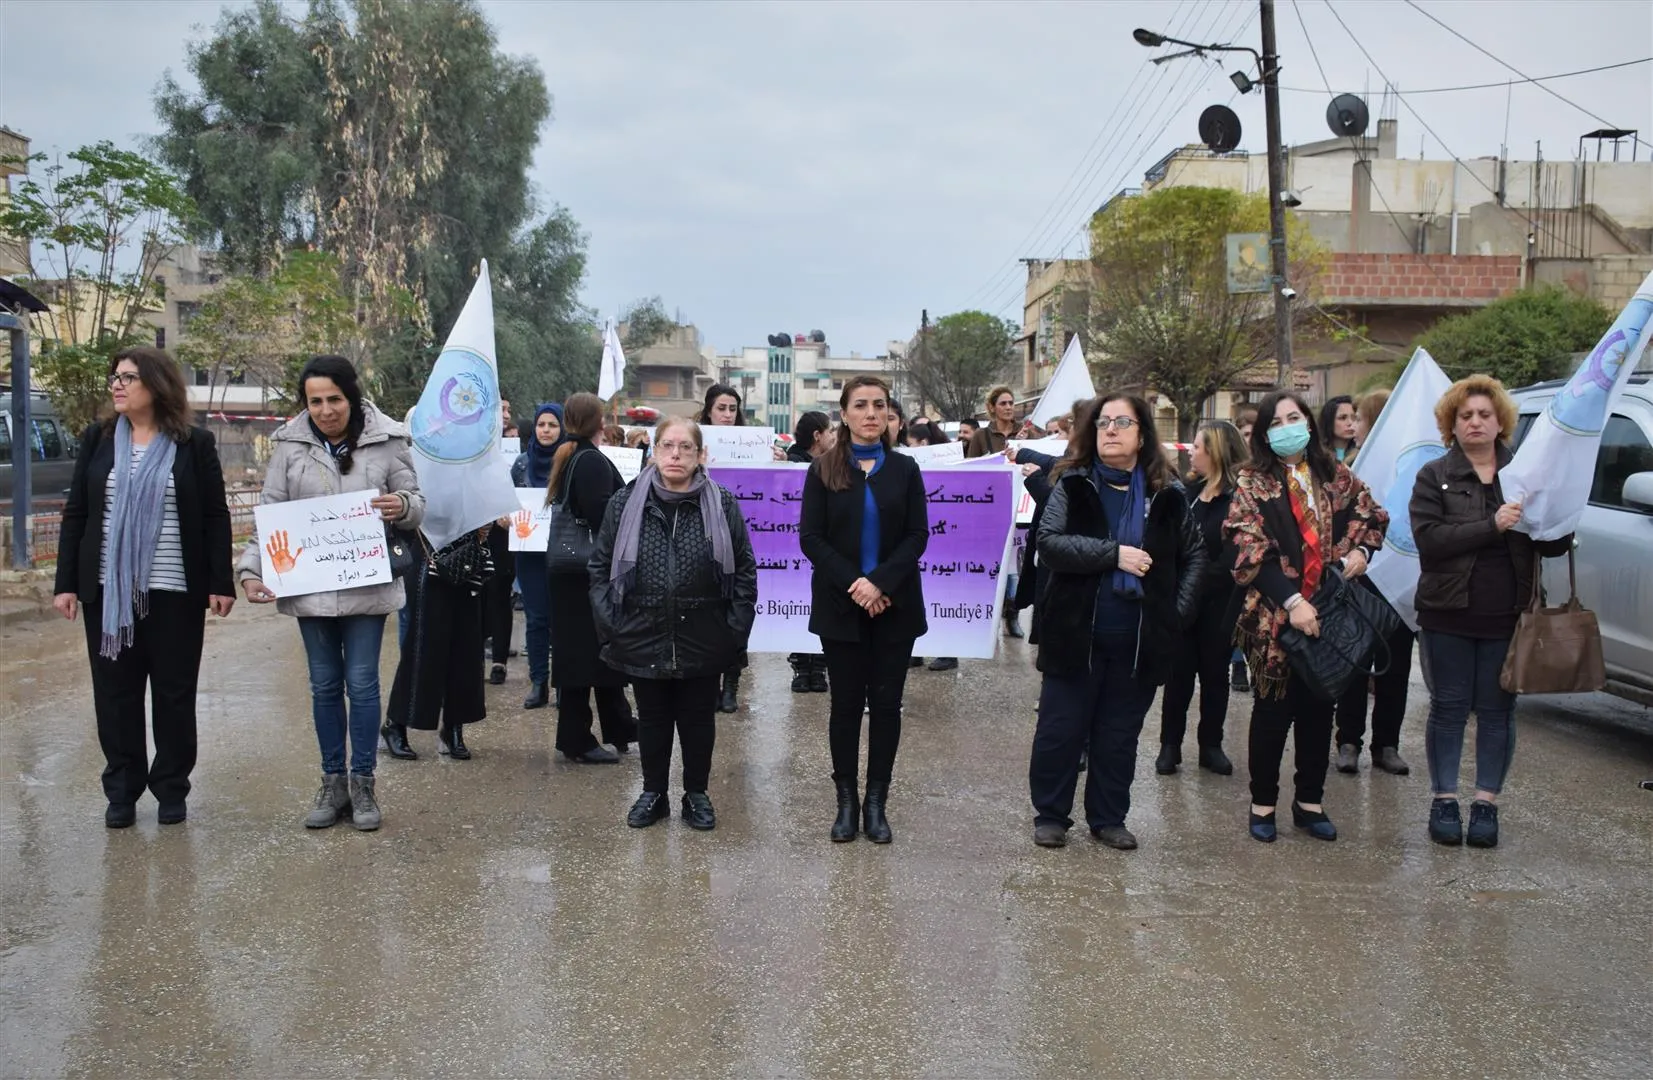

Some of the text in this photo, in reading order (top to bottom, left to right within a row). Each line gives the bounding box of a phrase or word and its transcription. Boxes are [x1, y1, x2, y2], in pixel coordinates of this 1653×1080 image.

[364, 568, 378, 578] ضد
[932, 561, 960, 576] اليوم
[966, 561, 985, 573] هذا
[931, 603, 982, 623] Tundiyê
